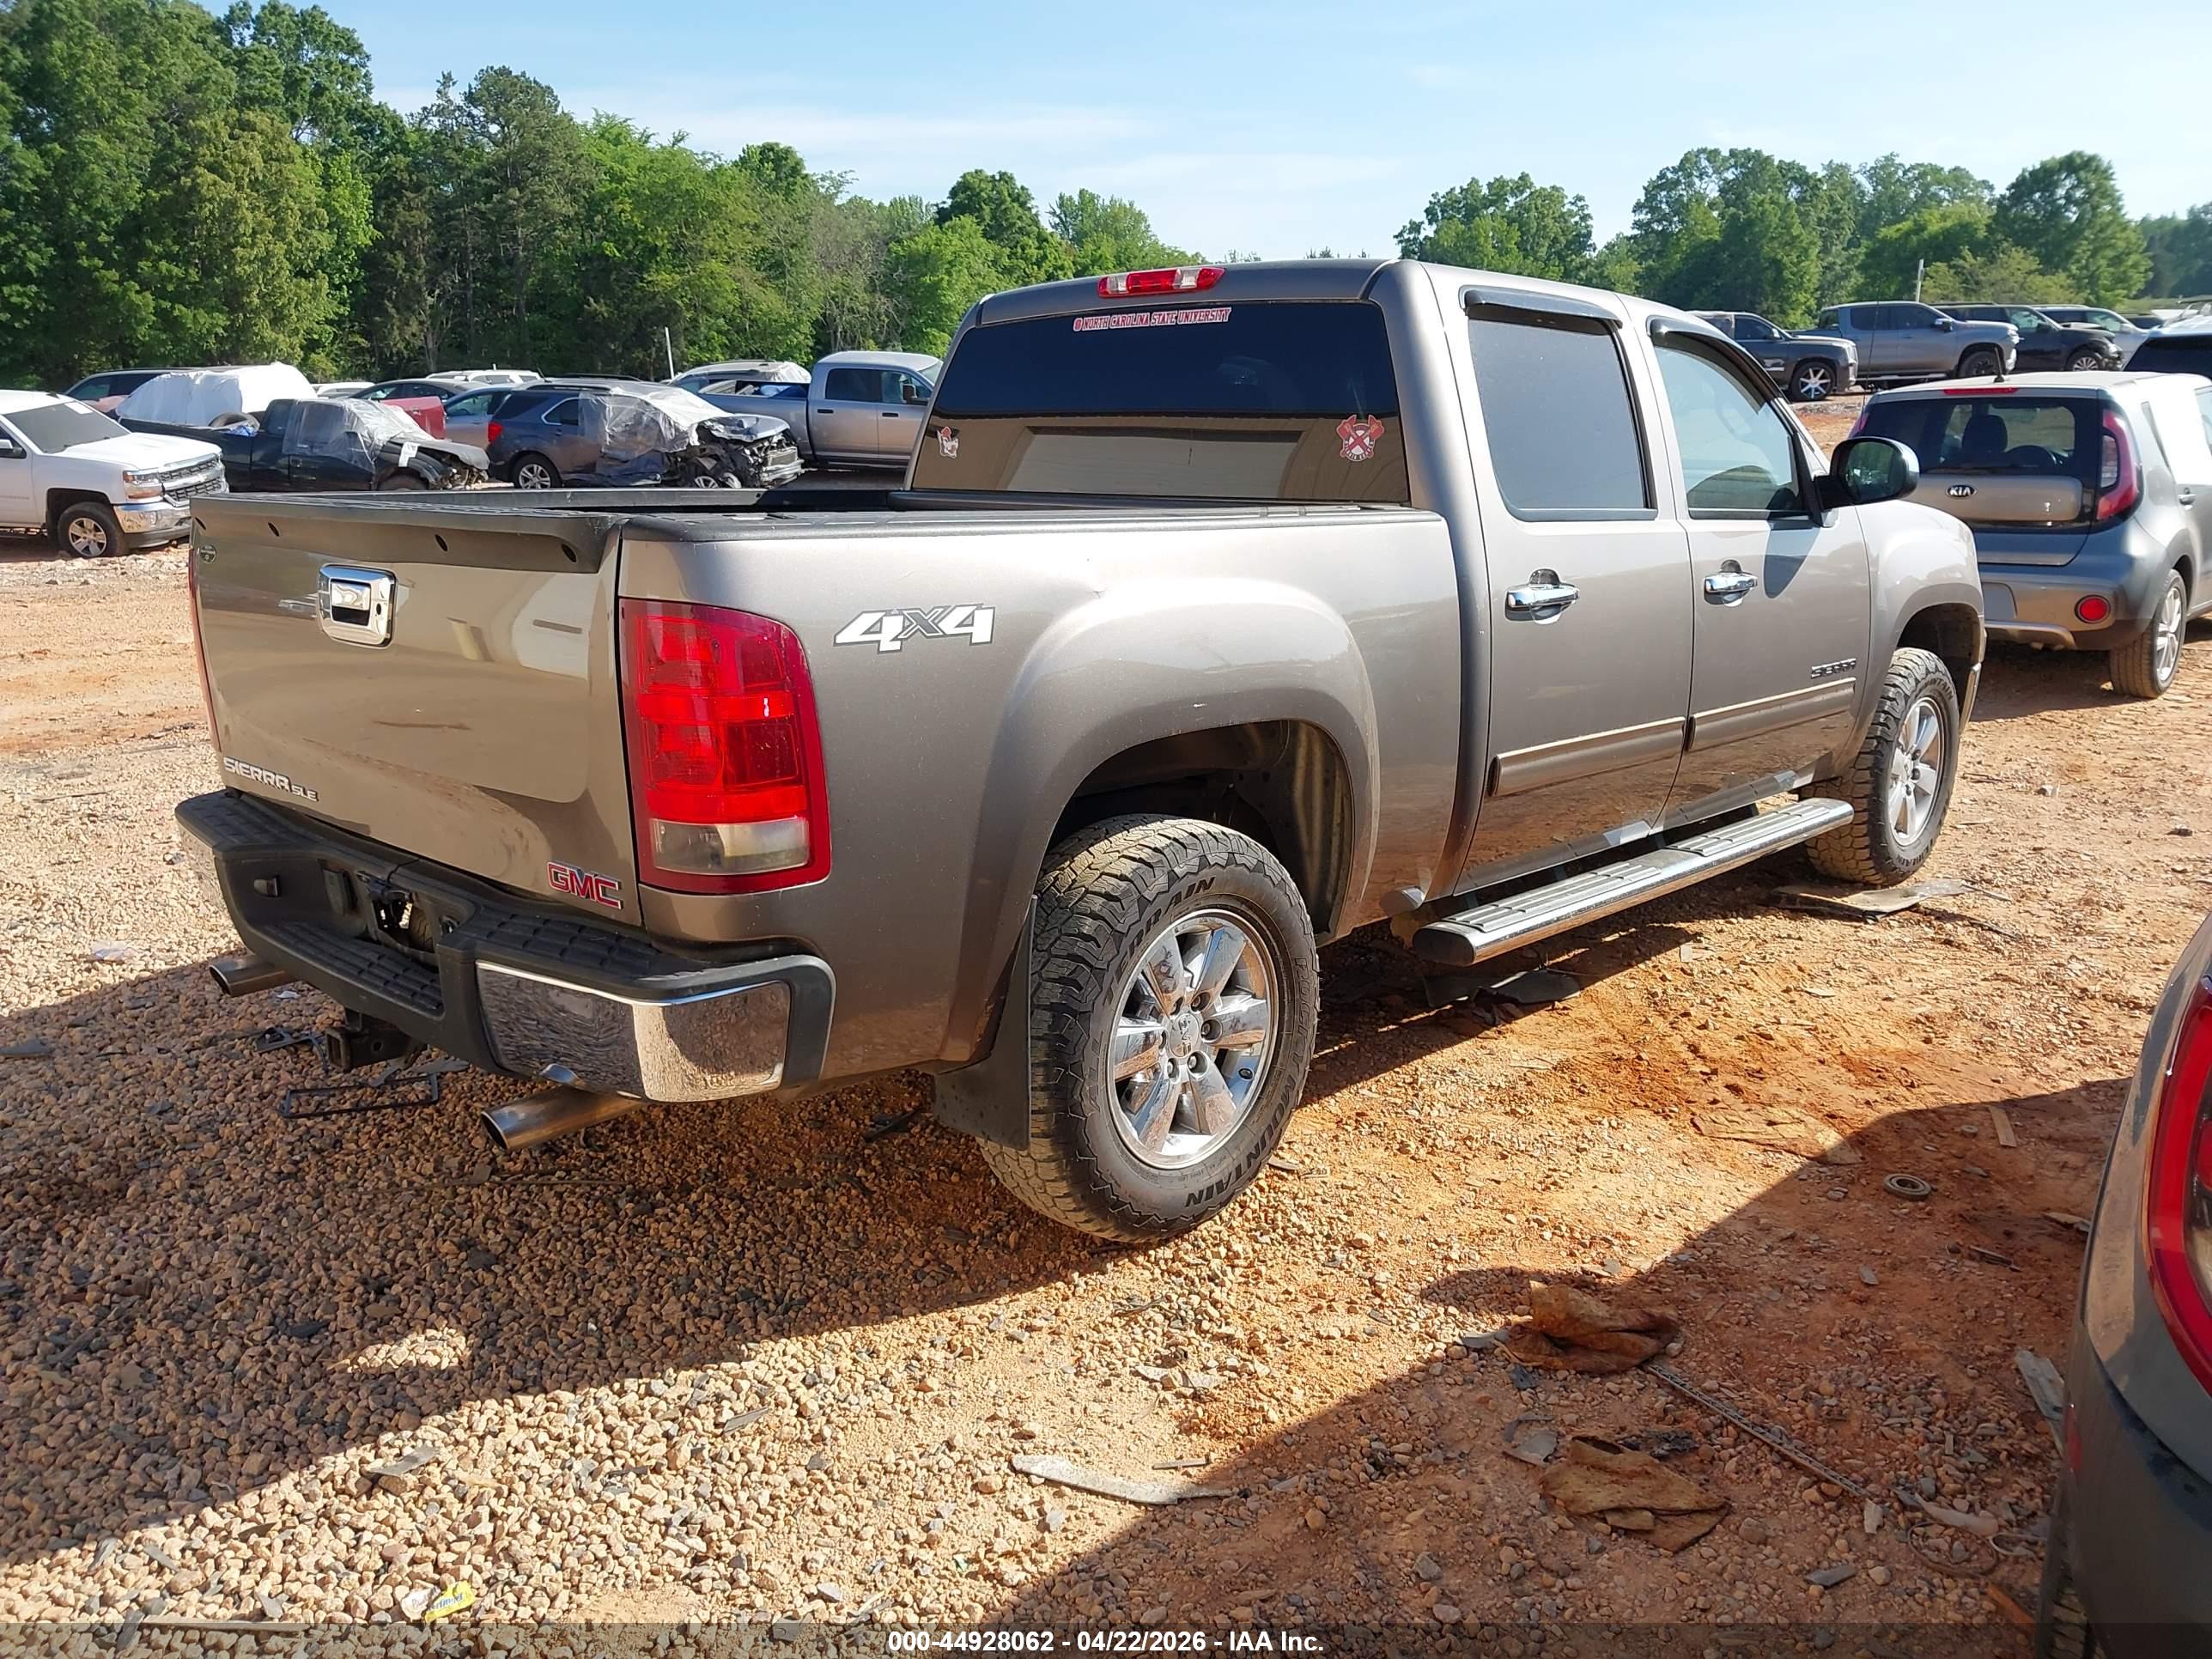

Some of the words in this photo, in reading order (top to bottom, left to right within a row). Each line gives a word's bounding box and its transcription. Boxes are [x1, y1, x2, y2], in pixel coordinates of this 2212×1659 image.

[1083, 315, 1109, 331] NORTH
[1109, 312, 1150, 329] CAROLINA
[1151, 310, 1177, 325] STATE
[1177, 307, 1232, 325] UNIVERSITY
[1949, 485, 1972, 496] KIA
[223, 756, 293, 793] SIERRA
[292, 784, 319, 802] SLE
[546, 860, 624, 910] GMC
[1101, 876, 1217, 1007] TERRAIN
[1185, 1075, 1297, 1207] MOUNTAIN
